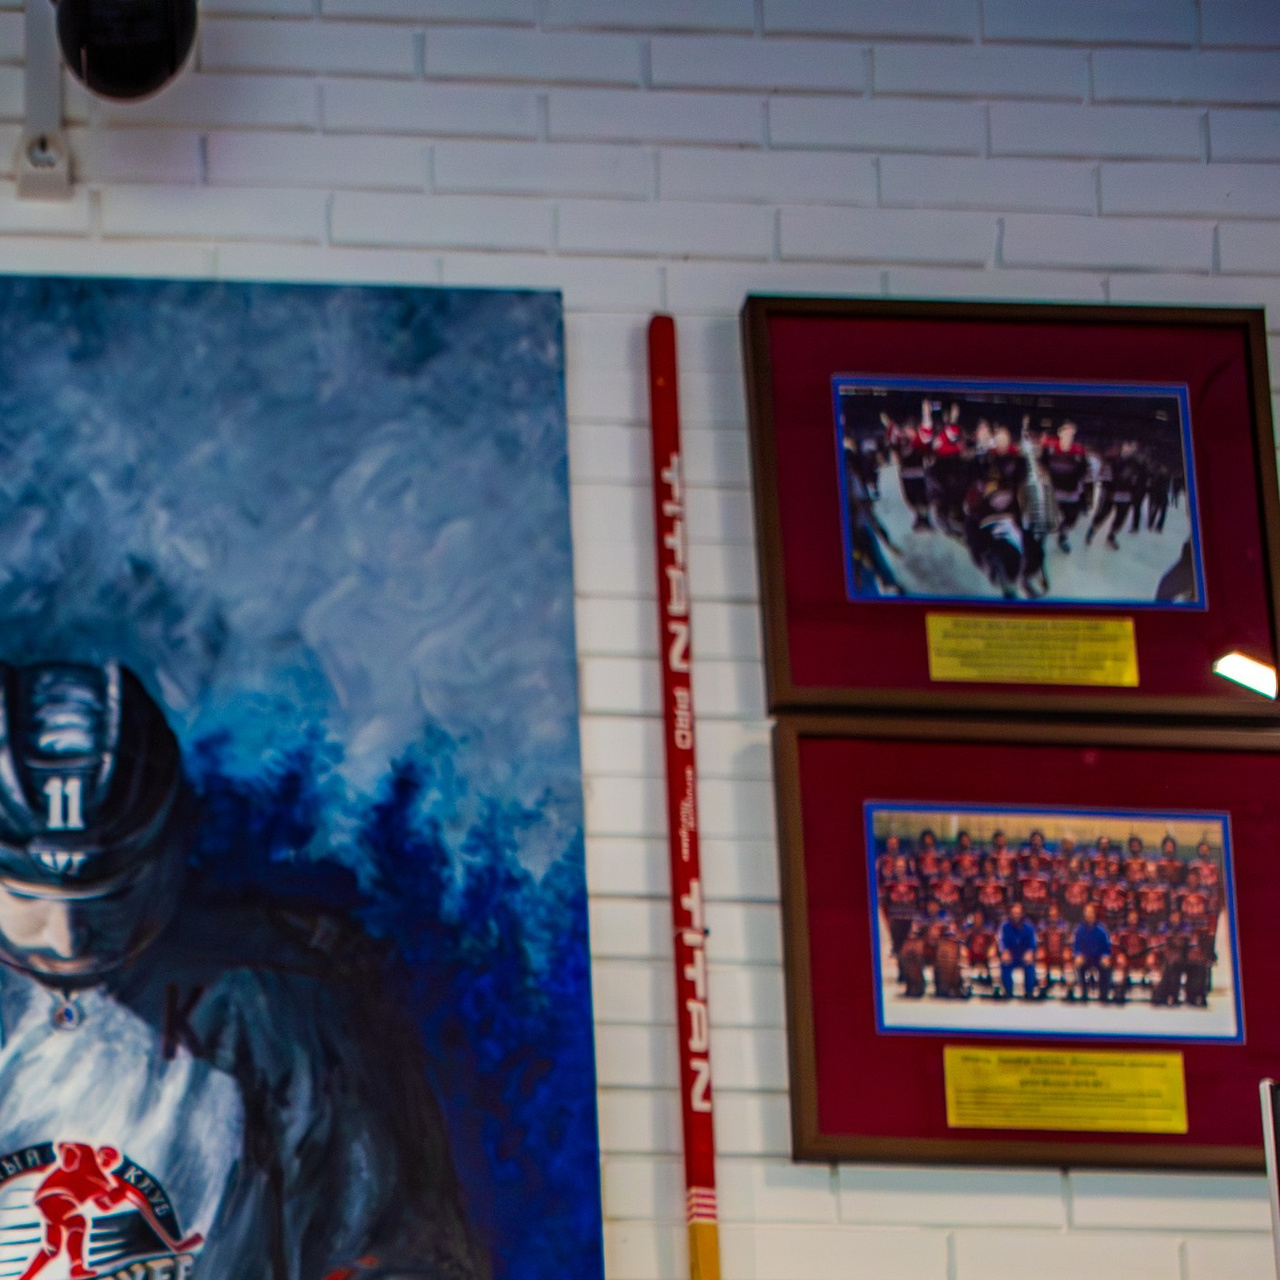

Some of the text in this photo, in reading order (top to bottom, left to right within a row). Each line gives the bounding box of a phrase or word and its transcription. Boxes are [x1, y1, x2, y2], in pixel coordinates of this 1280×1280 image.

[660, 451, 690, 674] TITAN
[43, 777, 84, 832] 11
[680, 877, 713, 1114] TITAN
